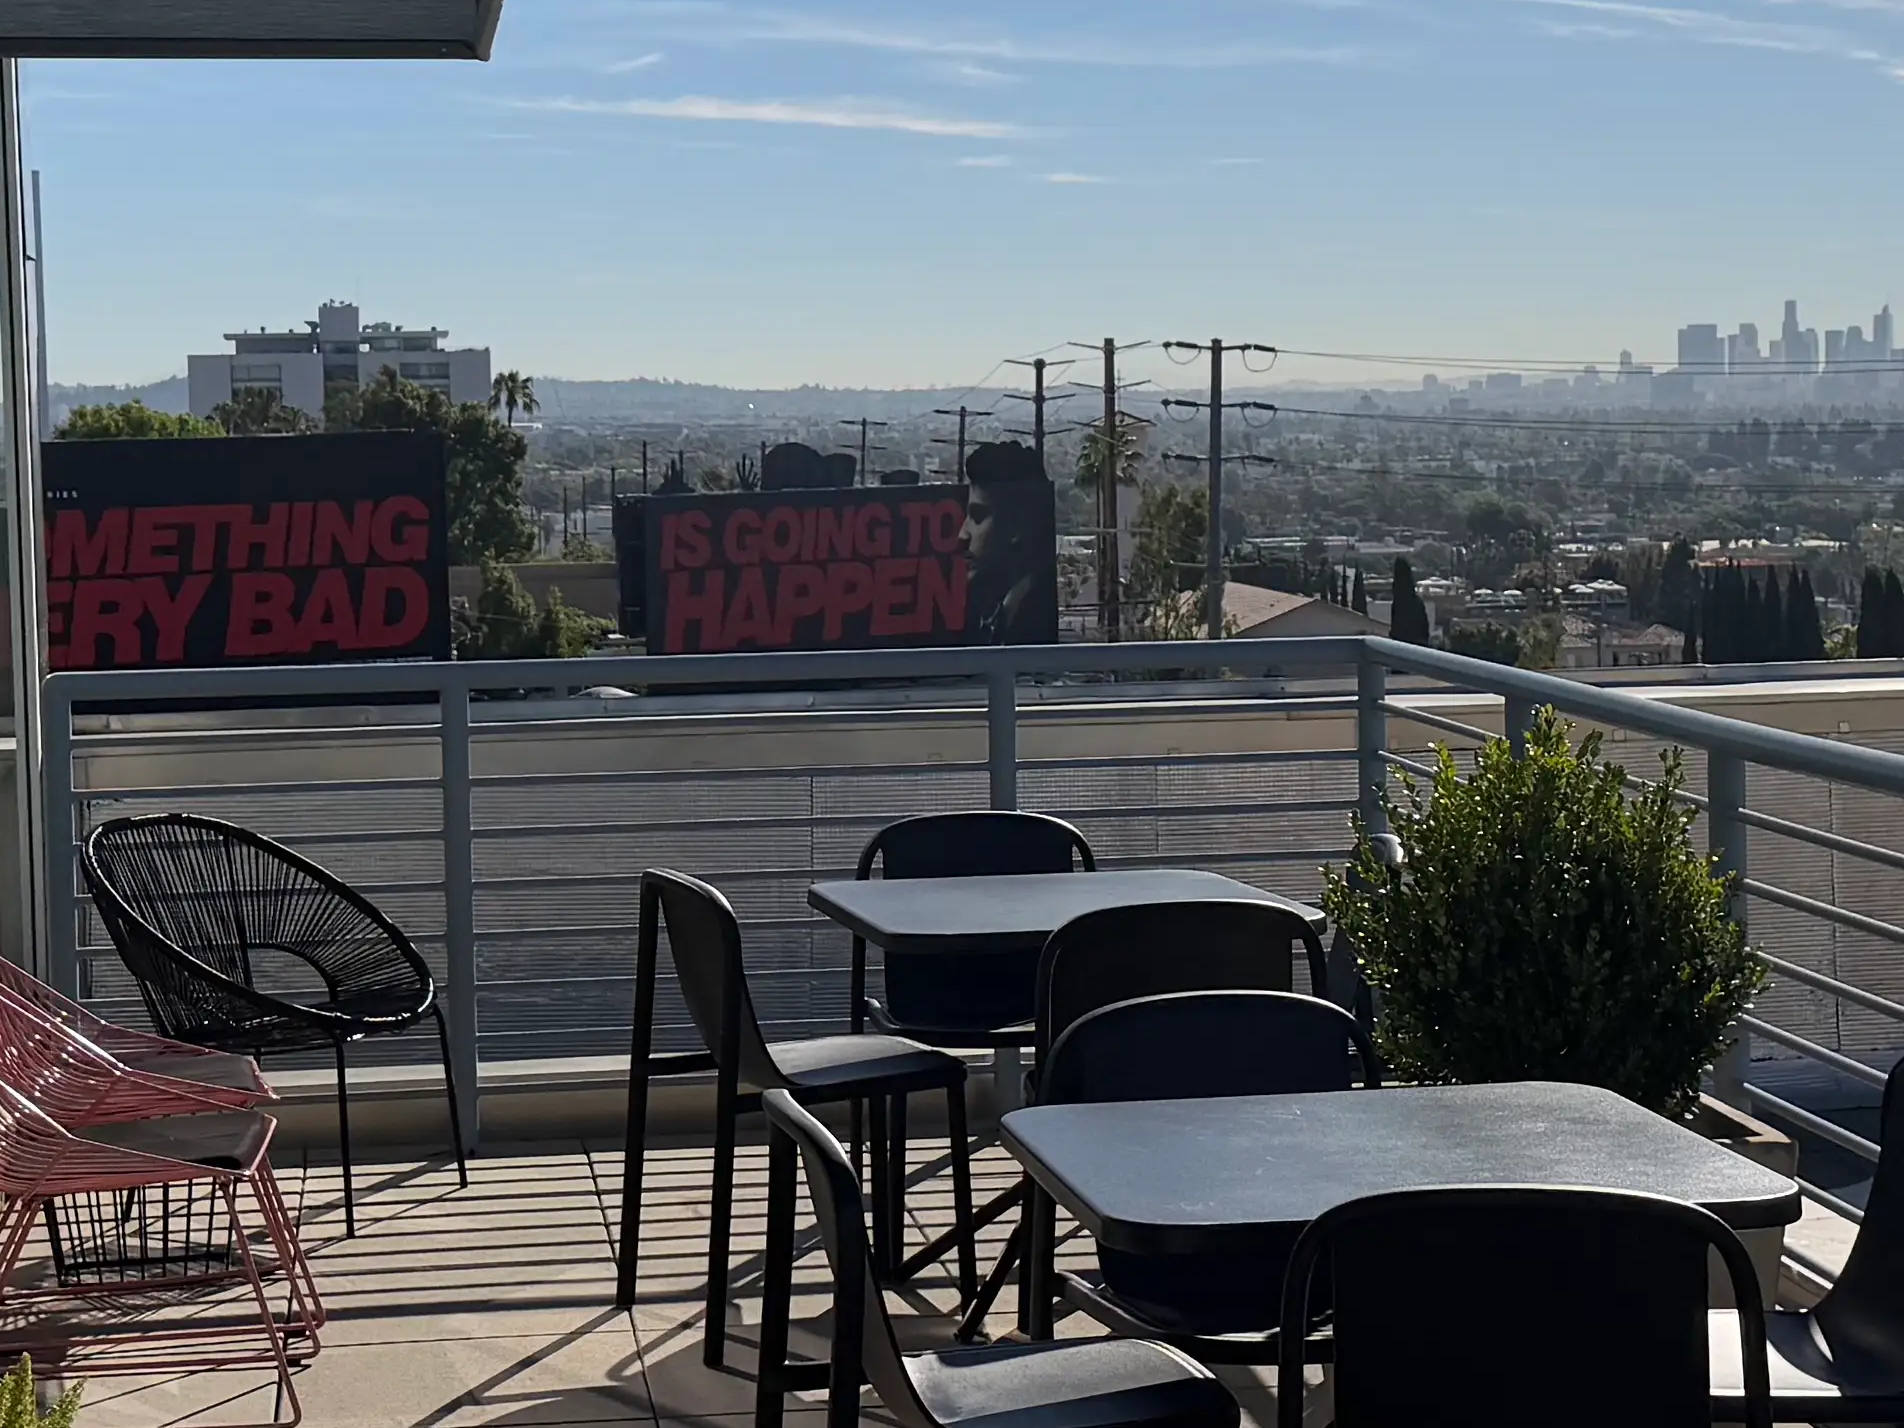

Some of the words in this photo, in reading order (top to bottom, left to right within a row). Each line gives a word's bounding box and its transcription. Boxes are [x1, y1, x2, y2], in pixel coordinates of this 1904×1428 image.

[45, 496, 429, 577] METHING
[660, 509, 712, 570] IS
[724, 502, 891, 565] GOING
[901, 498, 966, 555] TO
[225, 566, 429, 656] BAD
[664, 556, 969, 653] HAPPEN
